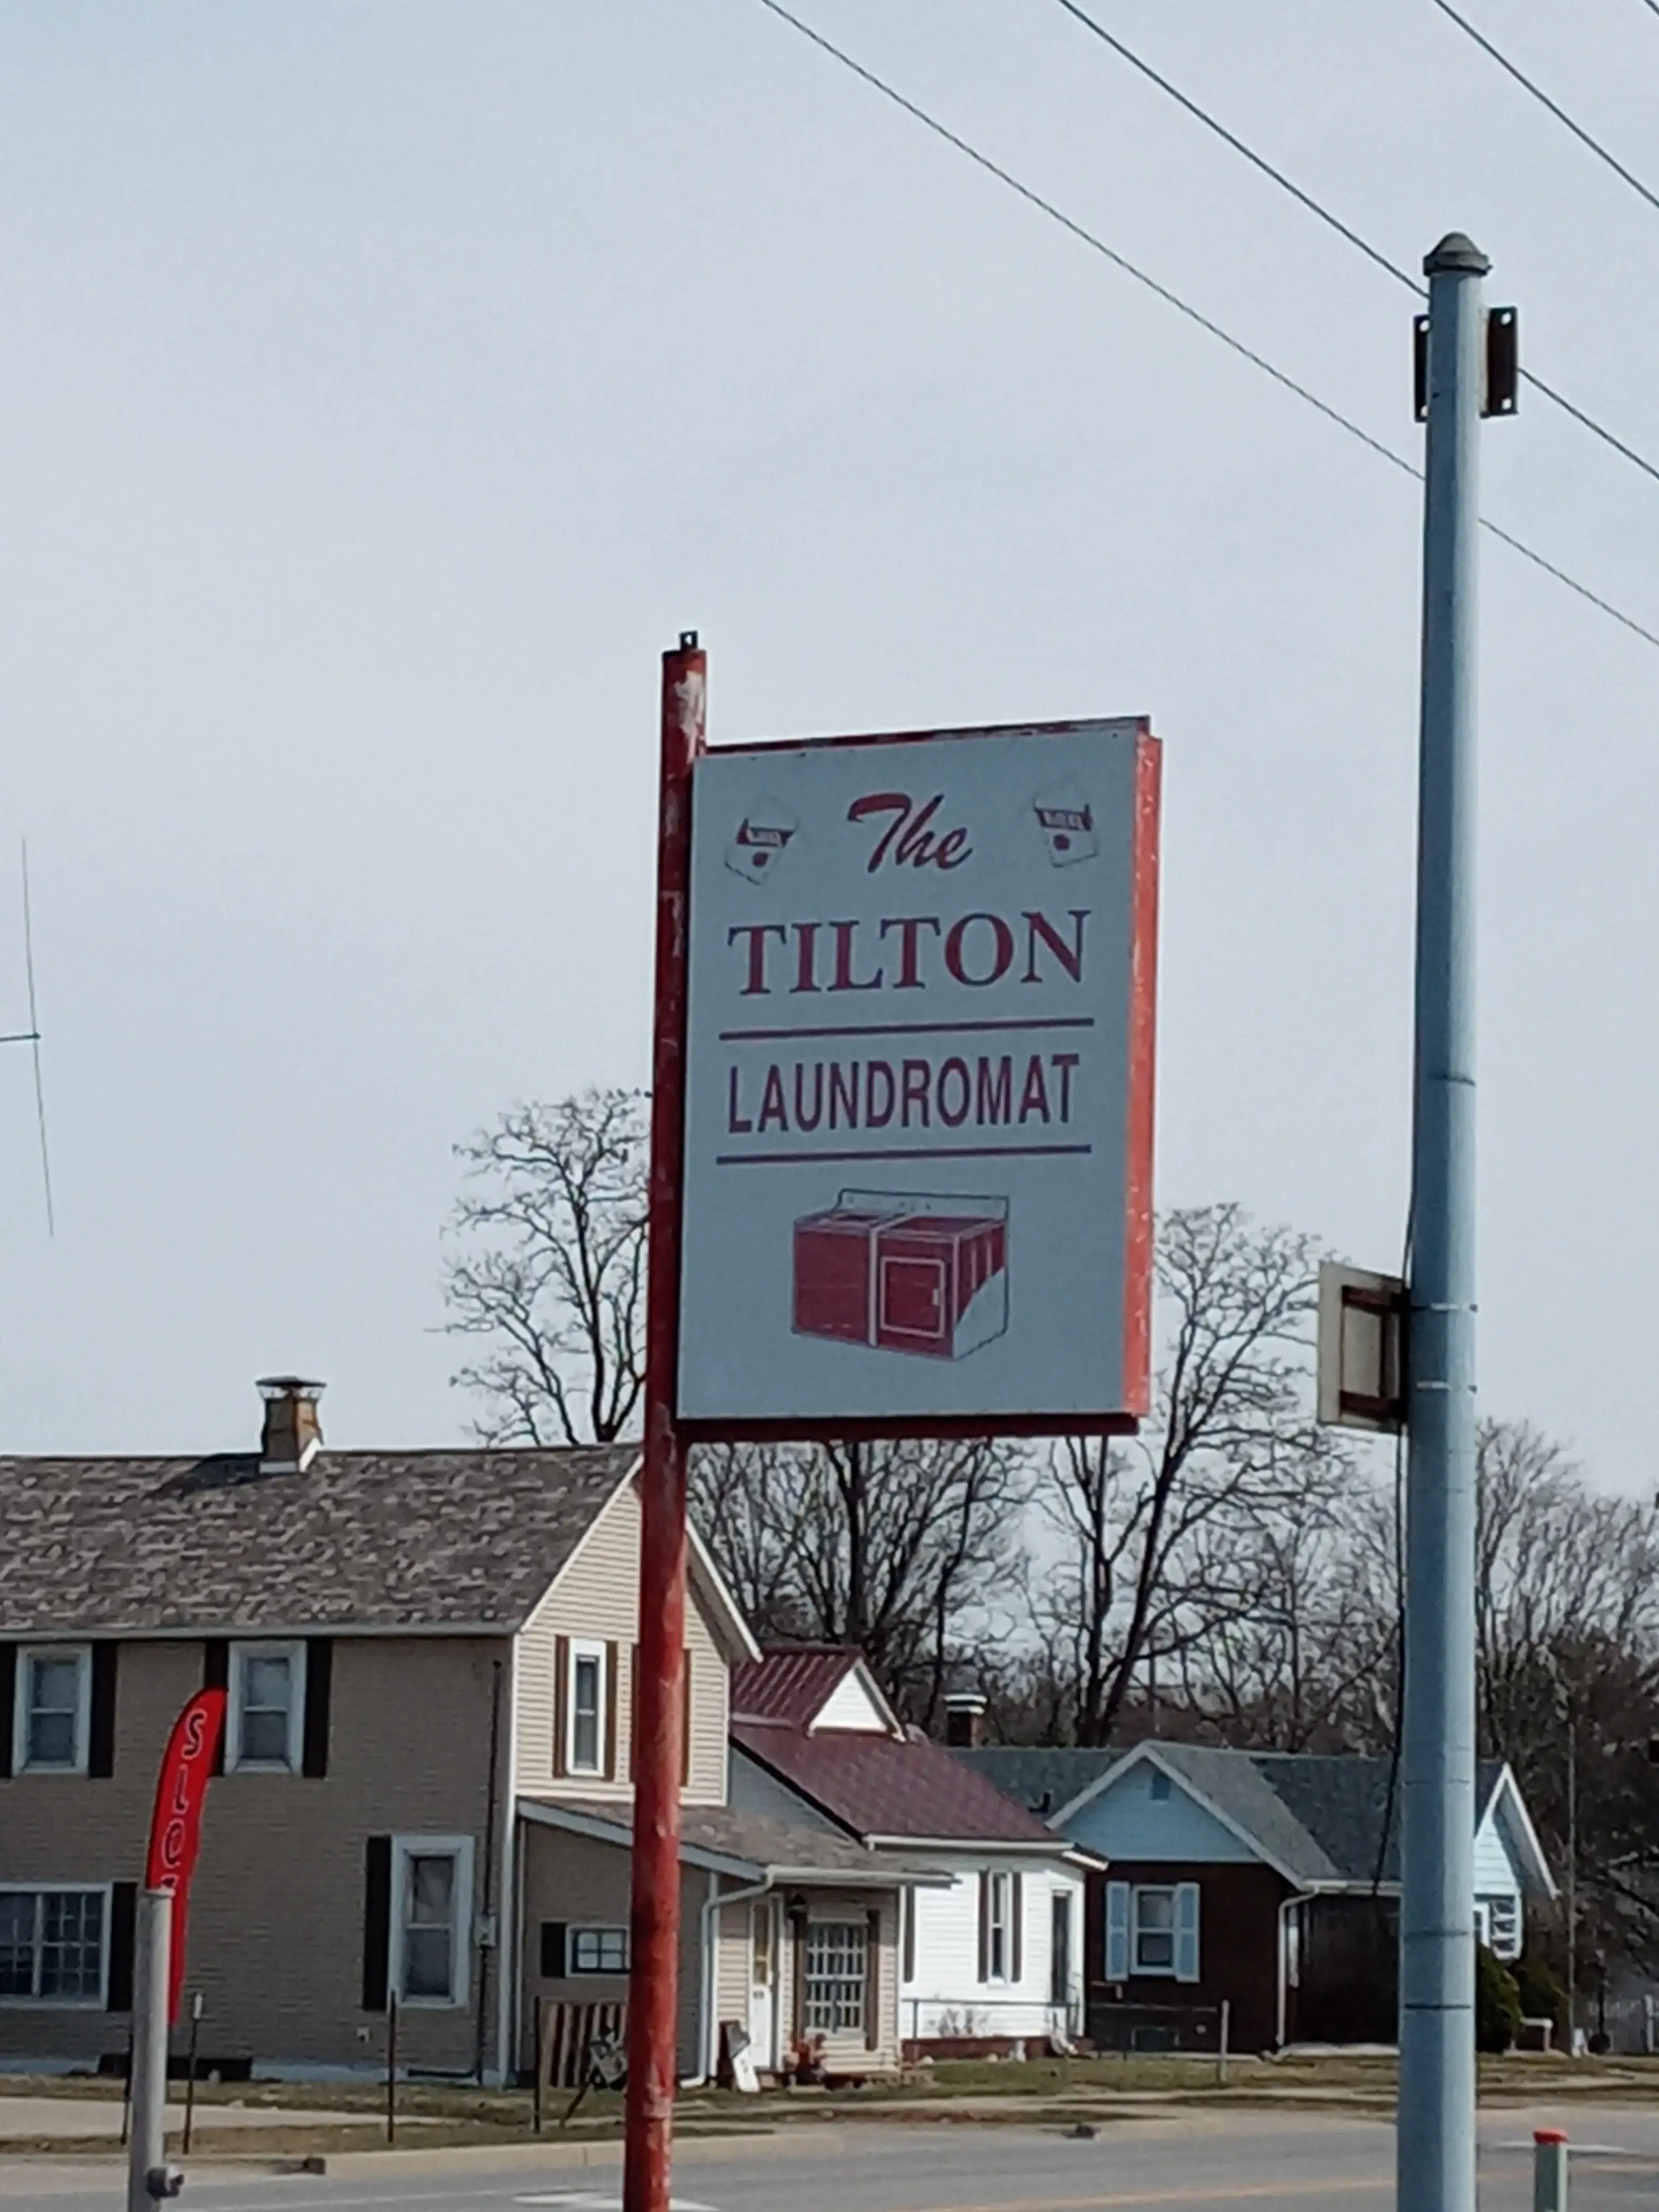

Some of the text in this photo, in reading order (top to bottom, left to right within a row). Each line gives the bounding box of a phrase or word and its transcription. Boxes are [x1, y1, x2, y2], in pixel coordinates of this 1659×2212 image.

[847, 793, 973, 874] The
[727, 909, 1092, 995] TILTON
[728, 1053, 1079, 1134] LAUNDROMAT
